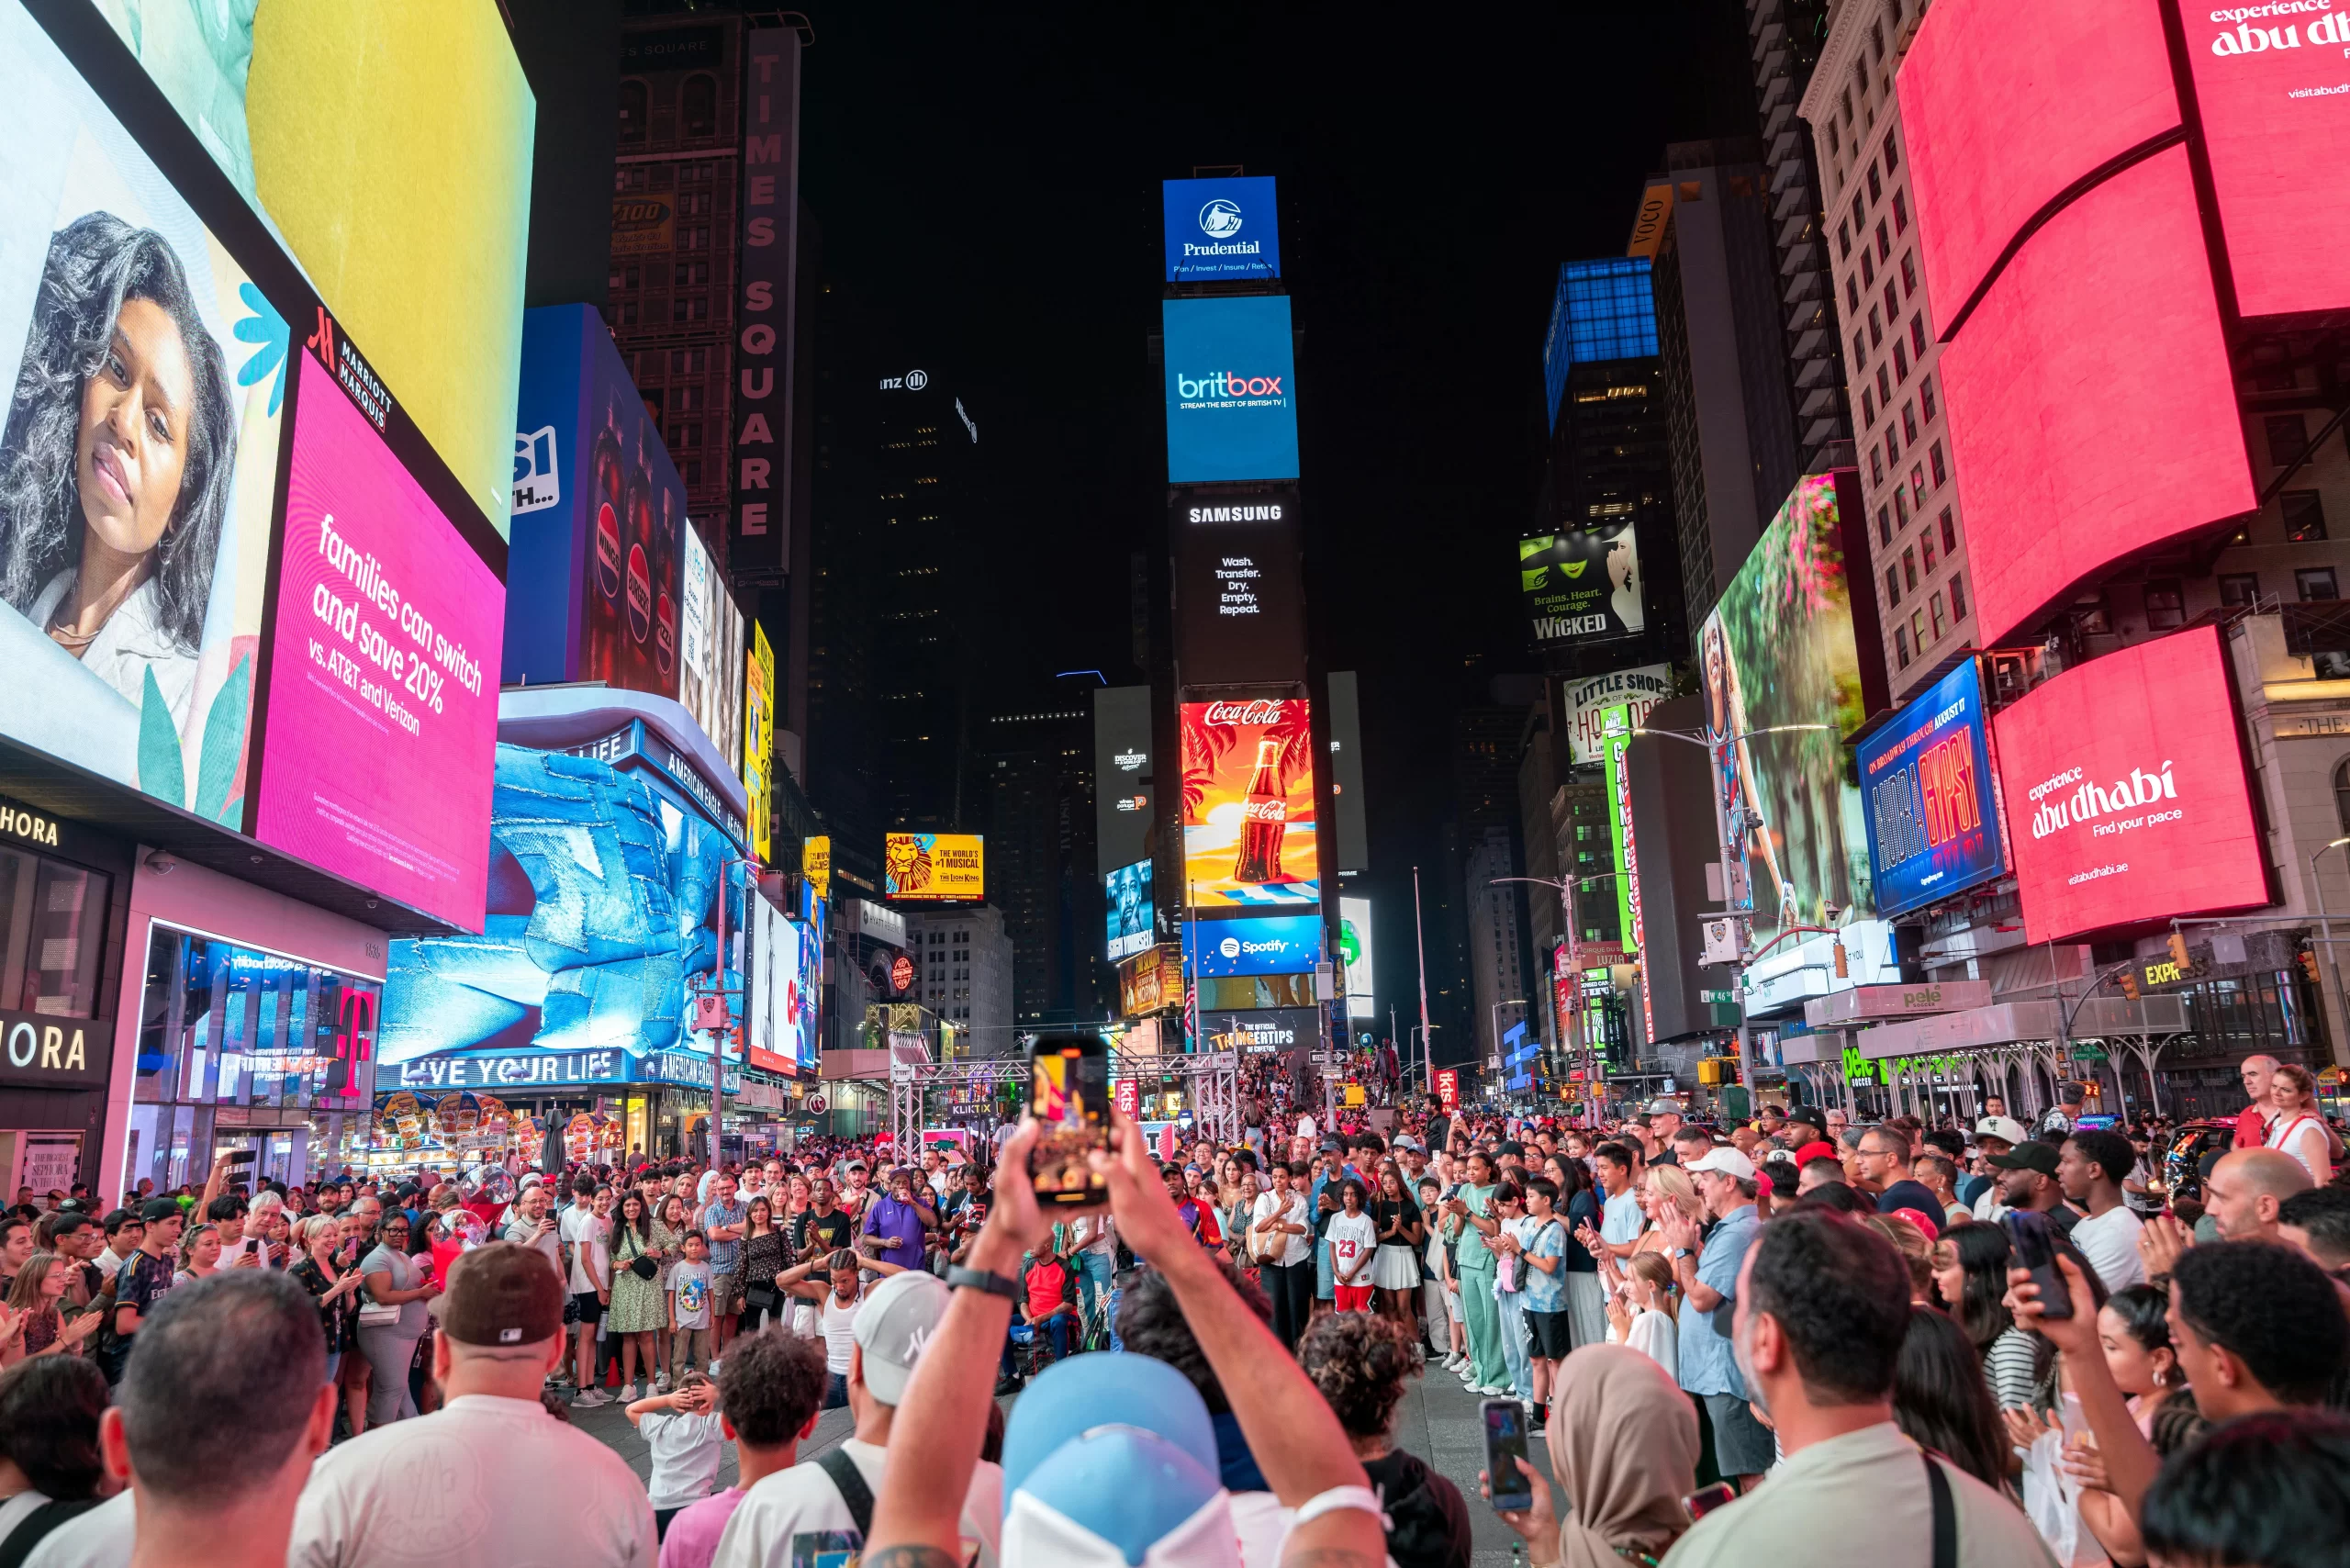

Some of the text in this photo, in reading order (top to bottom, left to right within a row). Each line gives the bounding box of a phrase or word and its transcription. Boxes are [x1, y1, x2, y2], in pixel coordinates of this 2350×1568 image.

[2210, 0, 2332, 24] experience
[644, 40, 708, 56] SQUARE
[2211, 22, 2301, 57] abu
[744, 54, 782, 248] TIMES
[1183, 241, 1261, 256] Prudential
[341, 341, 392, 413] MARRIOTT
[1179, 371, 1282, 398] britbox
[340, 363, 385, 428] MARQUIS
[736, 280, 778, 537] SQUARE
[1190, 505, 1281, 523] SAMSUNG
[599, 529, 620, 571] WINGS
[1222, 557, 1253, 567] Wash.
[1215, 568, 1261, 579] Transfer.
[627, 569, 650, 616] BURGERS
[1228, 581, 1249, 593] Dry.
[1534, 588, 1603, 606] Brains. Heart.
[319, 513, 399, 620] families
[401, 602, 432, 653] can
[434, 633, 482, 698] switch
[1222, 593, 1258, 605] Empty.
[1547, 600, 1591, 613] Courage.
[1219, 604, 1260, 617] Repeat.
[656, 620, 673, 652] PIZZA
[313, 583, 360, 644] and
[359, 622, 404, 680] save
[405, 651, 444, 715] 20%
[308, 637, 326, 668] vs.
[327, 647, 361, 690] AT&T
[360, 678, 383, 709] and
[384, 688, 420, 737] Verizon
[1575, 674, 1664, 708] LITTLE SHOP
[1869, 697, 1965, 775] ON BROADWAY THROUGH AUGUST 17
[2302, 717, 2345, 734] THE
[1114, 754, 1147, 762] DISCOVER
[667, 753, 704, 804] AMERICAN
[704, 789, 721, 820] EAGLE
[1918, 725, 1981, 847] GYPSY
[2029, 766, 2083, 801] experience
[2032, 759, 2178, 840] abu dhabi
[1613, 741, 1637, 914] CANNABIS
[1872, 762, 1929, 873] AUDRA
[2092, 809, 2183, 837] Find your pace
[935, 858, 979, 868] #1 MUSICAL
[939, 850, 979, 858] THE WORLD'S
[940, 874, 949, 882] THE
[2067, 862, 2129, 886] visitabudhabi.ae
[869, 915, 883, 927] HYATT
[1242, 939, 1287, 955] Spotify
[1583, 946, 1606, 954] CIRQUE
[1852, 949, 1863, 961] YOU
[1596, 953, 1625, 967] LUZIA
[1709, 991, 1716, 1001] W
[1717, 991, 1726, 1001] 46
[1903, 984, 1942, 1008] pelé
[1245, 1023, 1277, 1031] THE OFFICIAL
[0, 1020, 85, 1070] ORA
[476, 1057, 558, 1084] YOUR
[566, 1052, 611, 1081] LIFE
[661, 1053, 699, 1082] AMERICAN
[737, 1064, 744, 1072] 46
[1438, 1071, 1454, 1103] tkts
[1852, 1077, 1872, 1088] SOCCER
[1120, 1081, 1135, 1113] tkts
[953, 1104, 991, 1114] KLIKTIX
[35, 1153, 70, 1162] THE BIGGEST
[32, 1164, 68, 1176] SEPHORA
[1337, 1226, 1365, 1244] JORDAN
[1338, 1239, 1357, 1258] 23
